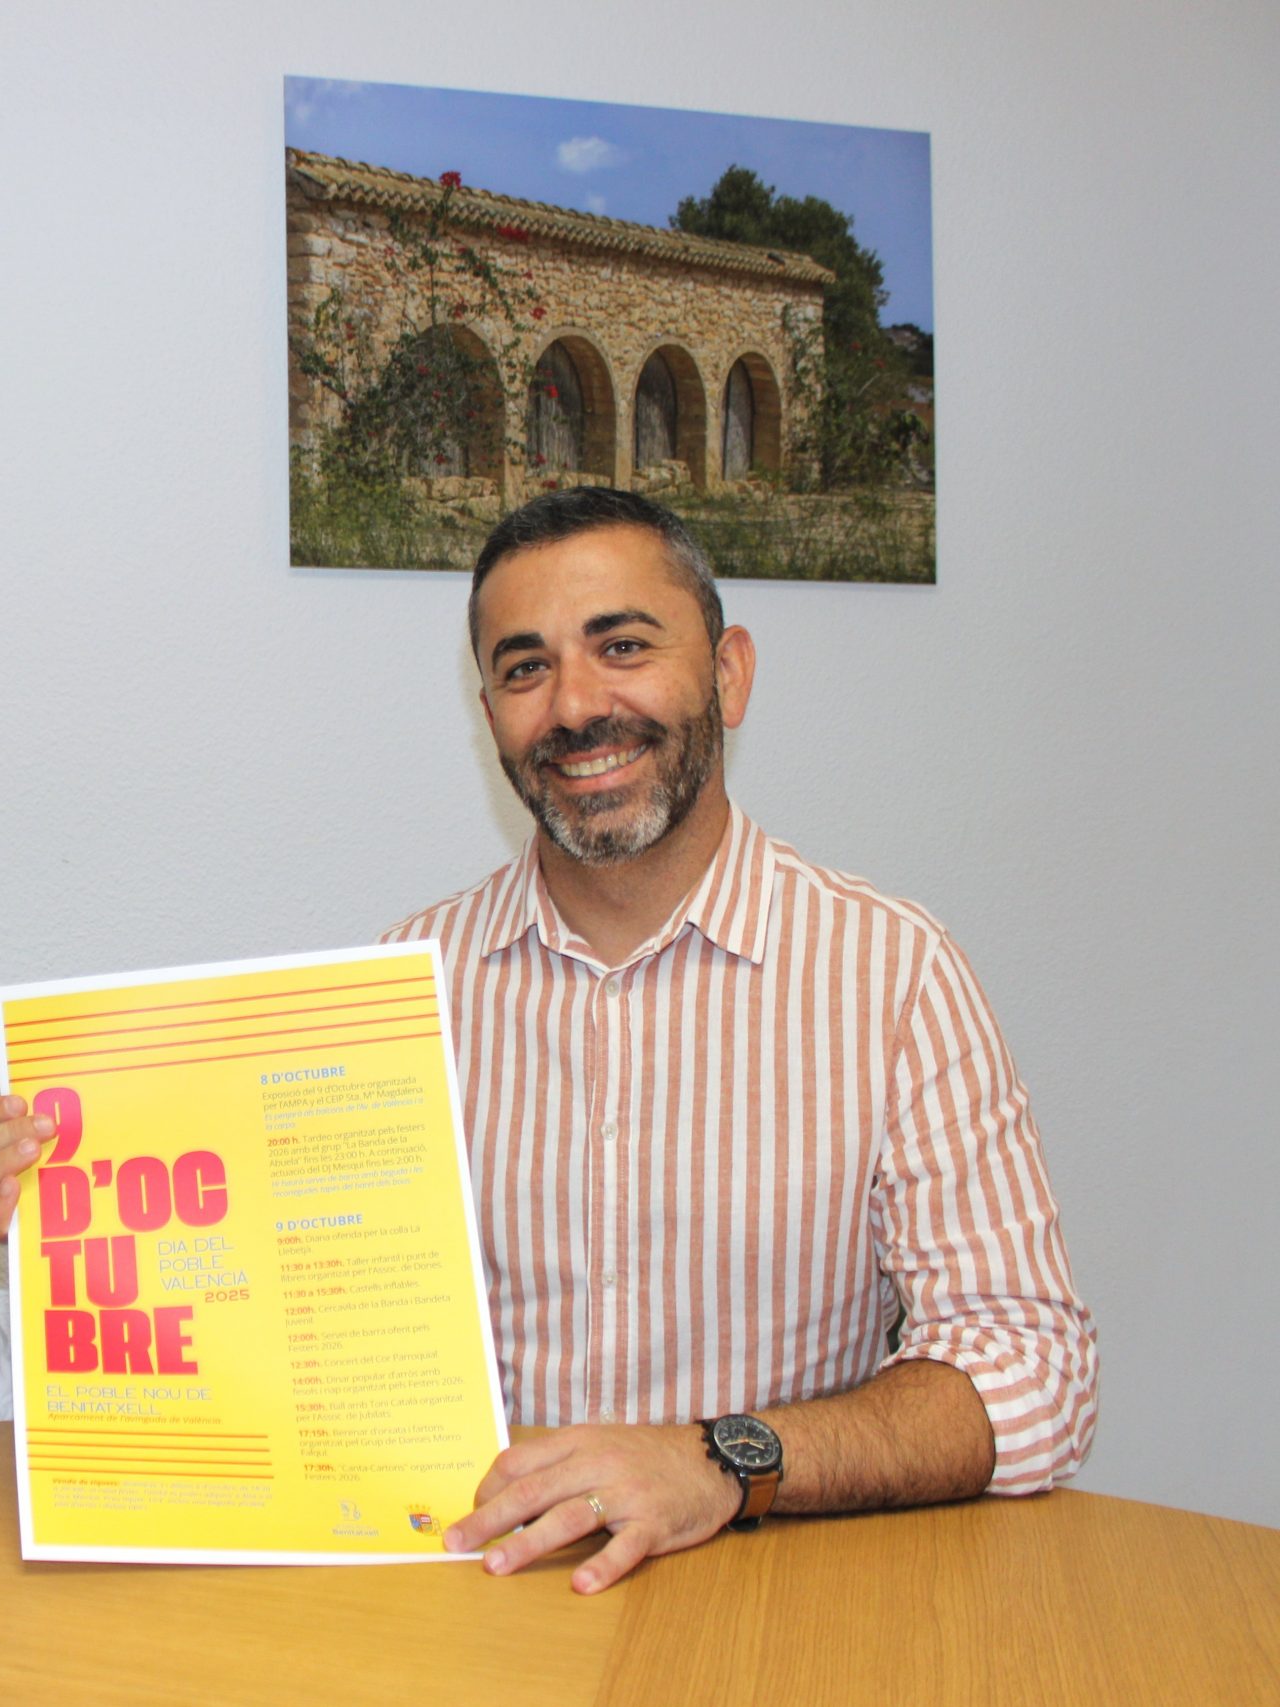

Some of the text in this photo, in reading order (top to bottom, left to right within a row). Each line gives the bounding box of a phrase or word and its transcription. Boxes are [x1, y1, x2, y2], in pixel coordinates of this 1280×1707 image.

[260, 1066, 346, 1085] 8 D'OCTUBRE
[261, 1088, 301, 1102] Exposició
[302, 1086, 315, 1096] del
[366, 1075, 416, 1091] organitzada
[32, 1087, 82, 1164] 9
[267, 1122, 425, 1147] 20:00 h. Tardeo organitzat pels festers
[270, 1166, 305, 1178] actuació
[306, 1164, 320, 1174] del
[321, 1163, 331, 1175] DJ
[365, 1158, 381, 1168] fins
[382, 1156, 394, 1166] les
[395, 1154, 414, 1165] 2:00
[303, 1154, 319, 1164] fins
[319, 1153, 332, 1162] les
[334, 1150, 357, 1161] 23:00
[358, 1149, 367, 1158] h.
[38, 1150, 228, 1238] D'OC
[275, 1214, 363, 1232] 9 D'OCTUBRE
[158, 1236, 234, 1256] DIA DEL
[41, 1235, 139, 1308] TU
[159, 1254, 224, 1273] POBLE
[204, 1289, 250, 1303] 2025
[283, 1289, 306, 1299] 11:30
[349, 1282, 381, 1293] Castells
[44, 1306, 198, 1375] BRE
[292, 1375, 323, 1386] 14:00h.
[325, 1374, 349, 1384] Dinar
[351, 1371, 385, 1384] popular
[420, 1367, 440, 1377] amb
[46, 1384, 212, 1400] EL POBLE NOU DE
[303, 1463, 335, 1473] 17:30h.
